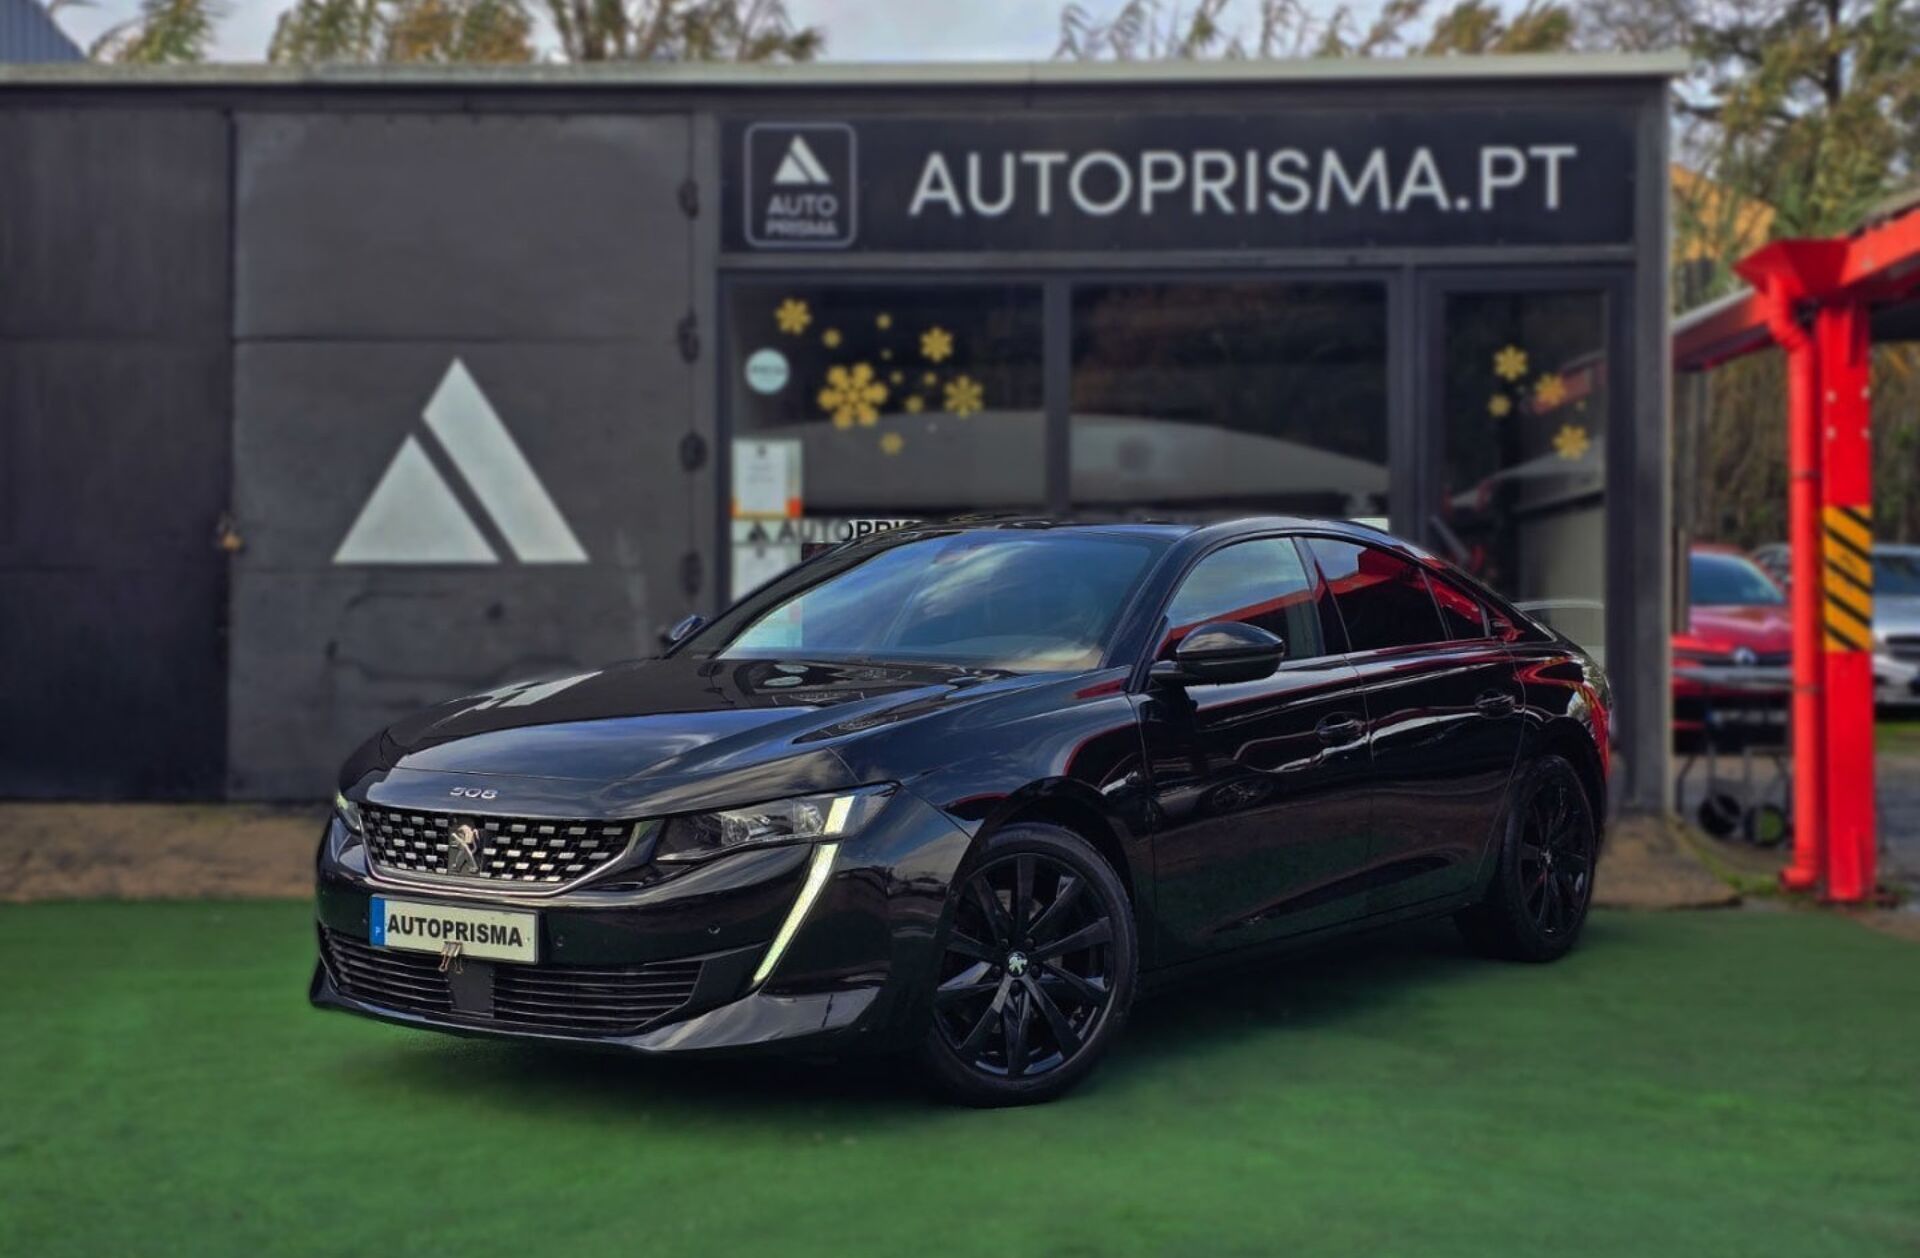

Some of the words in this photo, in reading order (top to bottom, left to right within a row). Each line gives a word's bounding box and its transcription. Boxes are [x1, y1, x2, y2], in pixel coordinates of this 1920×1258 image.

[909, 145, 1577, 216] AUTOPRISMA.PT
[767, 193, 839, 218] AUTO
[450, 786, 498, 799] 508
[387, 913, 523, 948] AUTOPRISMA
